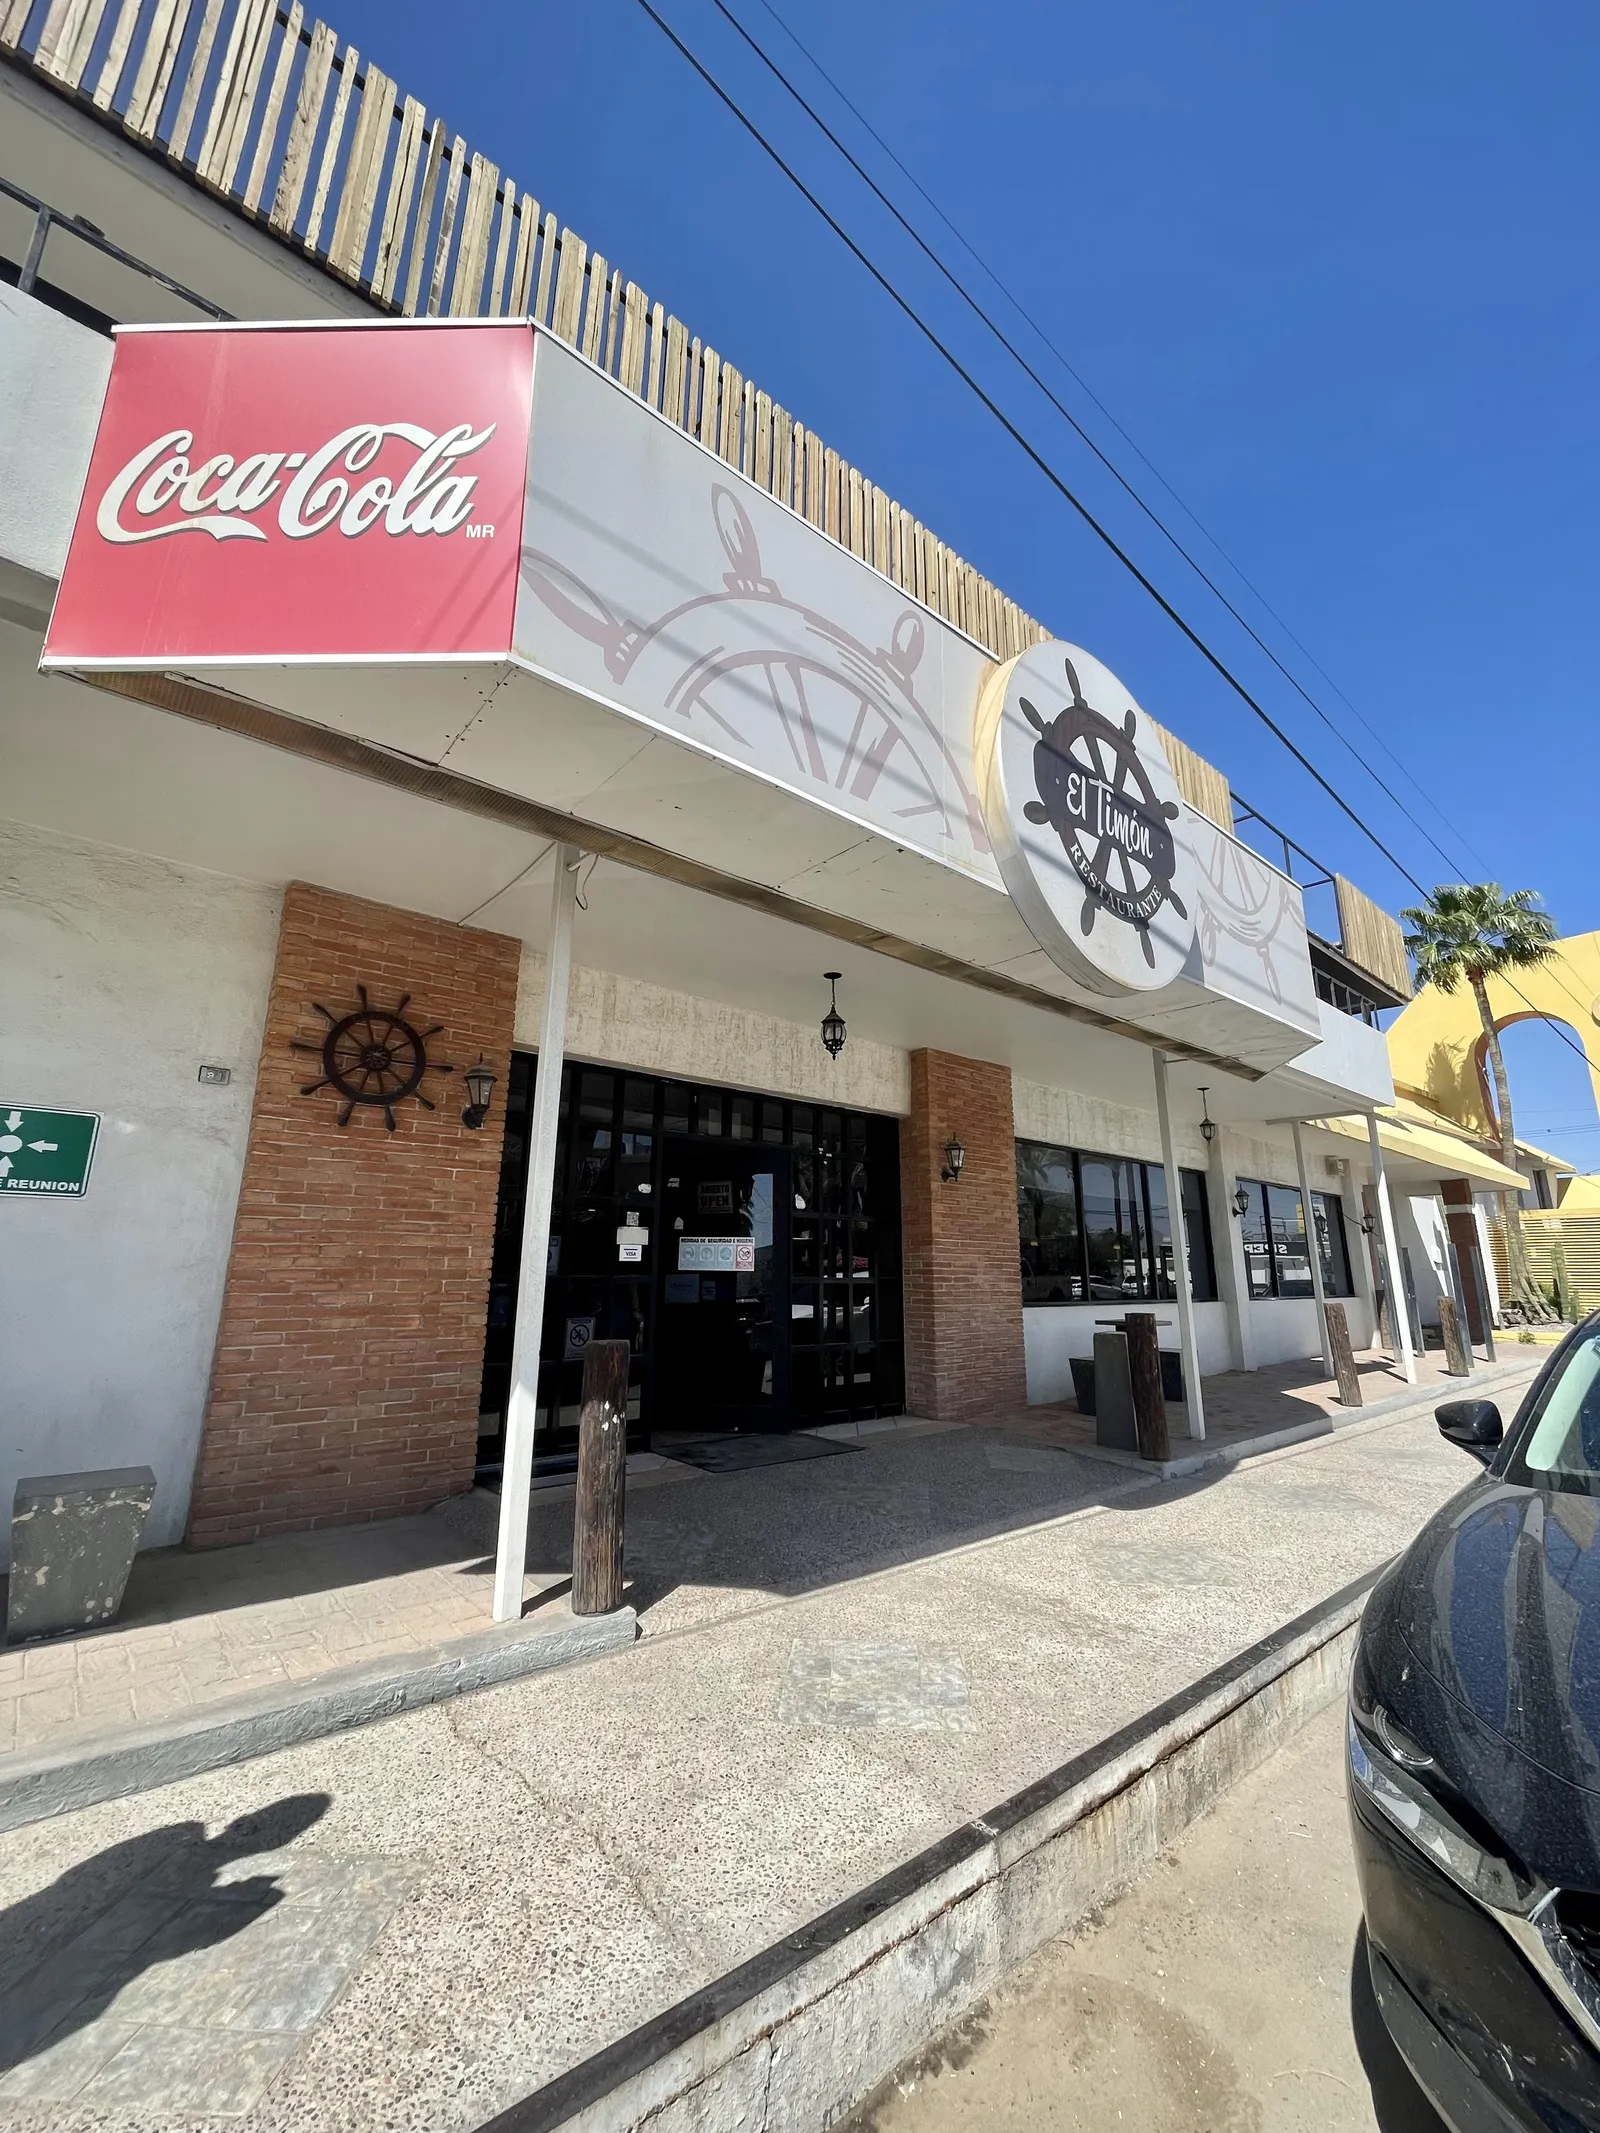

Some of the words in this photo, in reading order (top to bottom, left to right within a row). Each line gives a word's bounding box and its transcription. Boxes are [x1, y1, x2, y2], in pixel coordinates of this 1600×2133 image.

[96, 421, 497, 543] Coca-Cola
[465, 524, 495, 538] MR
[1066, 772, 1087, 821] El
[1088, 778, 1154, 859] Timón
[1069, 842, 1162, 919] RESTAURANTE
[7, 1179, 80, 1191] REUNION
[700, 1195, 730, 1207] OPEN
